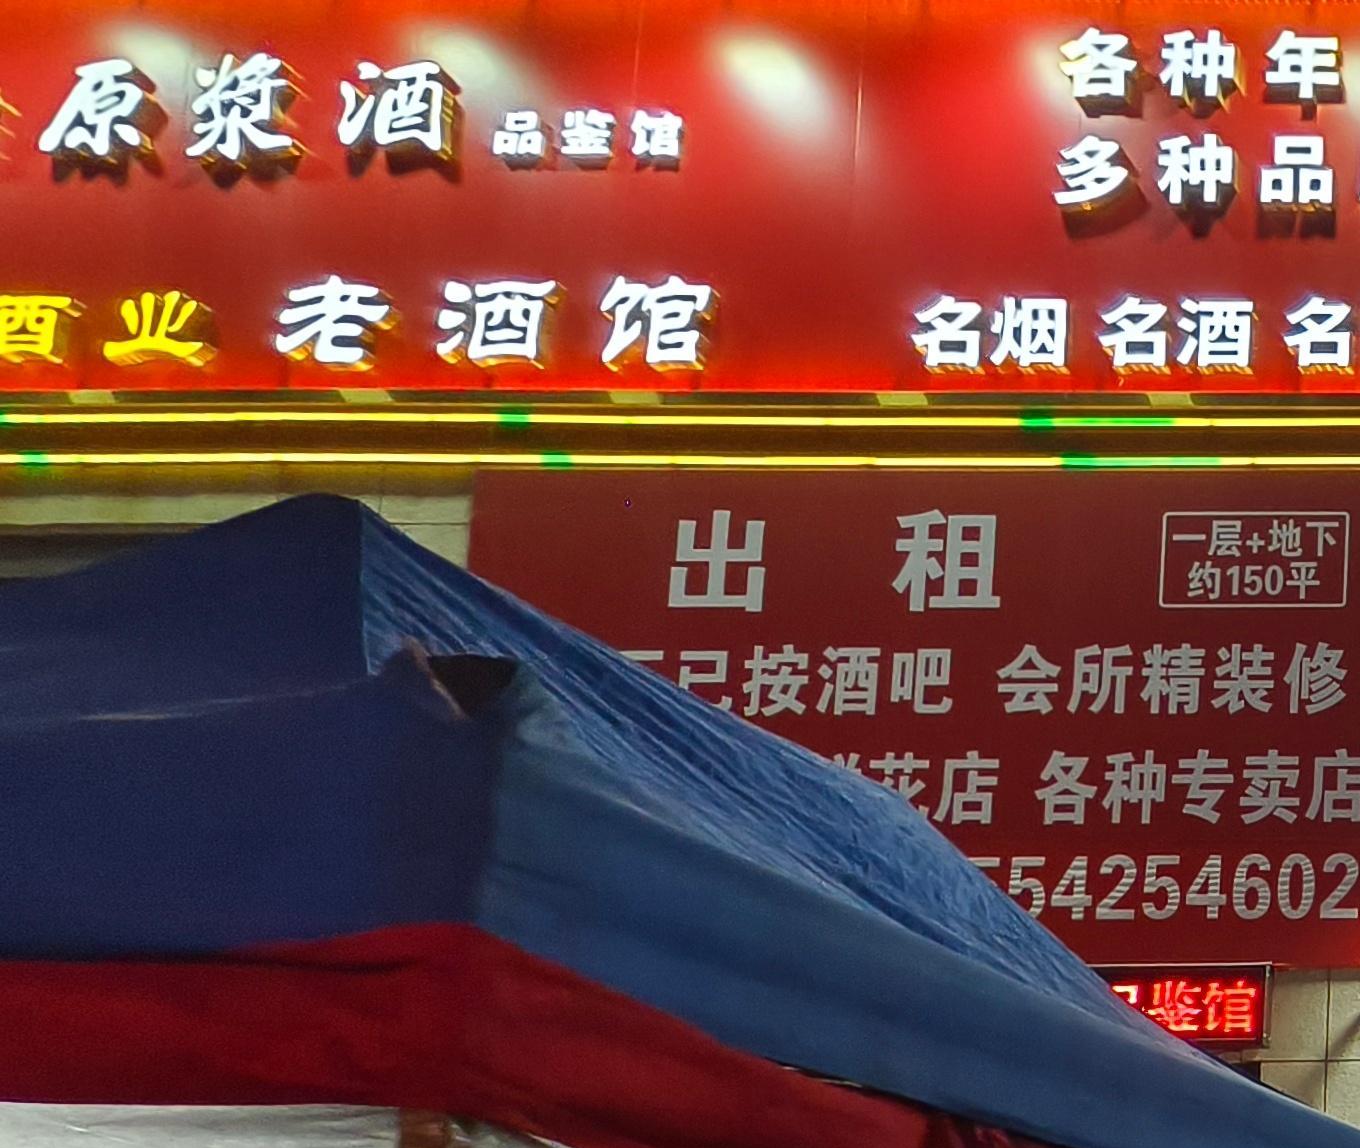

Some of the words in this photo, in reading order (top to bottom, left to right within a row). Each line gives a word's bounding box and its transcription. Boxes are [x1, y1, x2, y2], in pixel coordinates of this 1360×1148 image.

[492, 110, 682, 157] 品鉴馆
[276, 275, 712, 365] 老酒馆
[911, 296, 1069, 368] 名烟
[1100, 297, 1254, 368] 名酒
[667, 508, 1000, 612] 出租
[1172, 518, 1340, 558] 一层+地下
[1187, 560, 1321, 600] 约150平
[618, 644, 954, 718] 已按酒吧
[997, 641, 1349, 716] 会所精装修
[832, 750, 1000, 826] 花店
[1111, 980, 1257, 1033] 鉴馆
